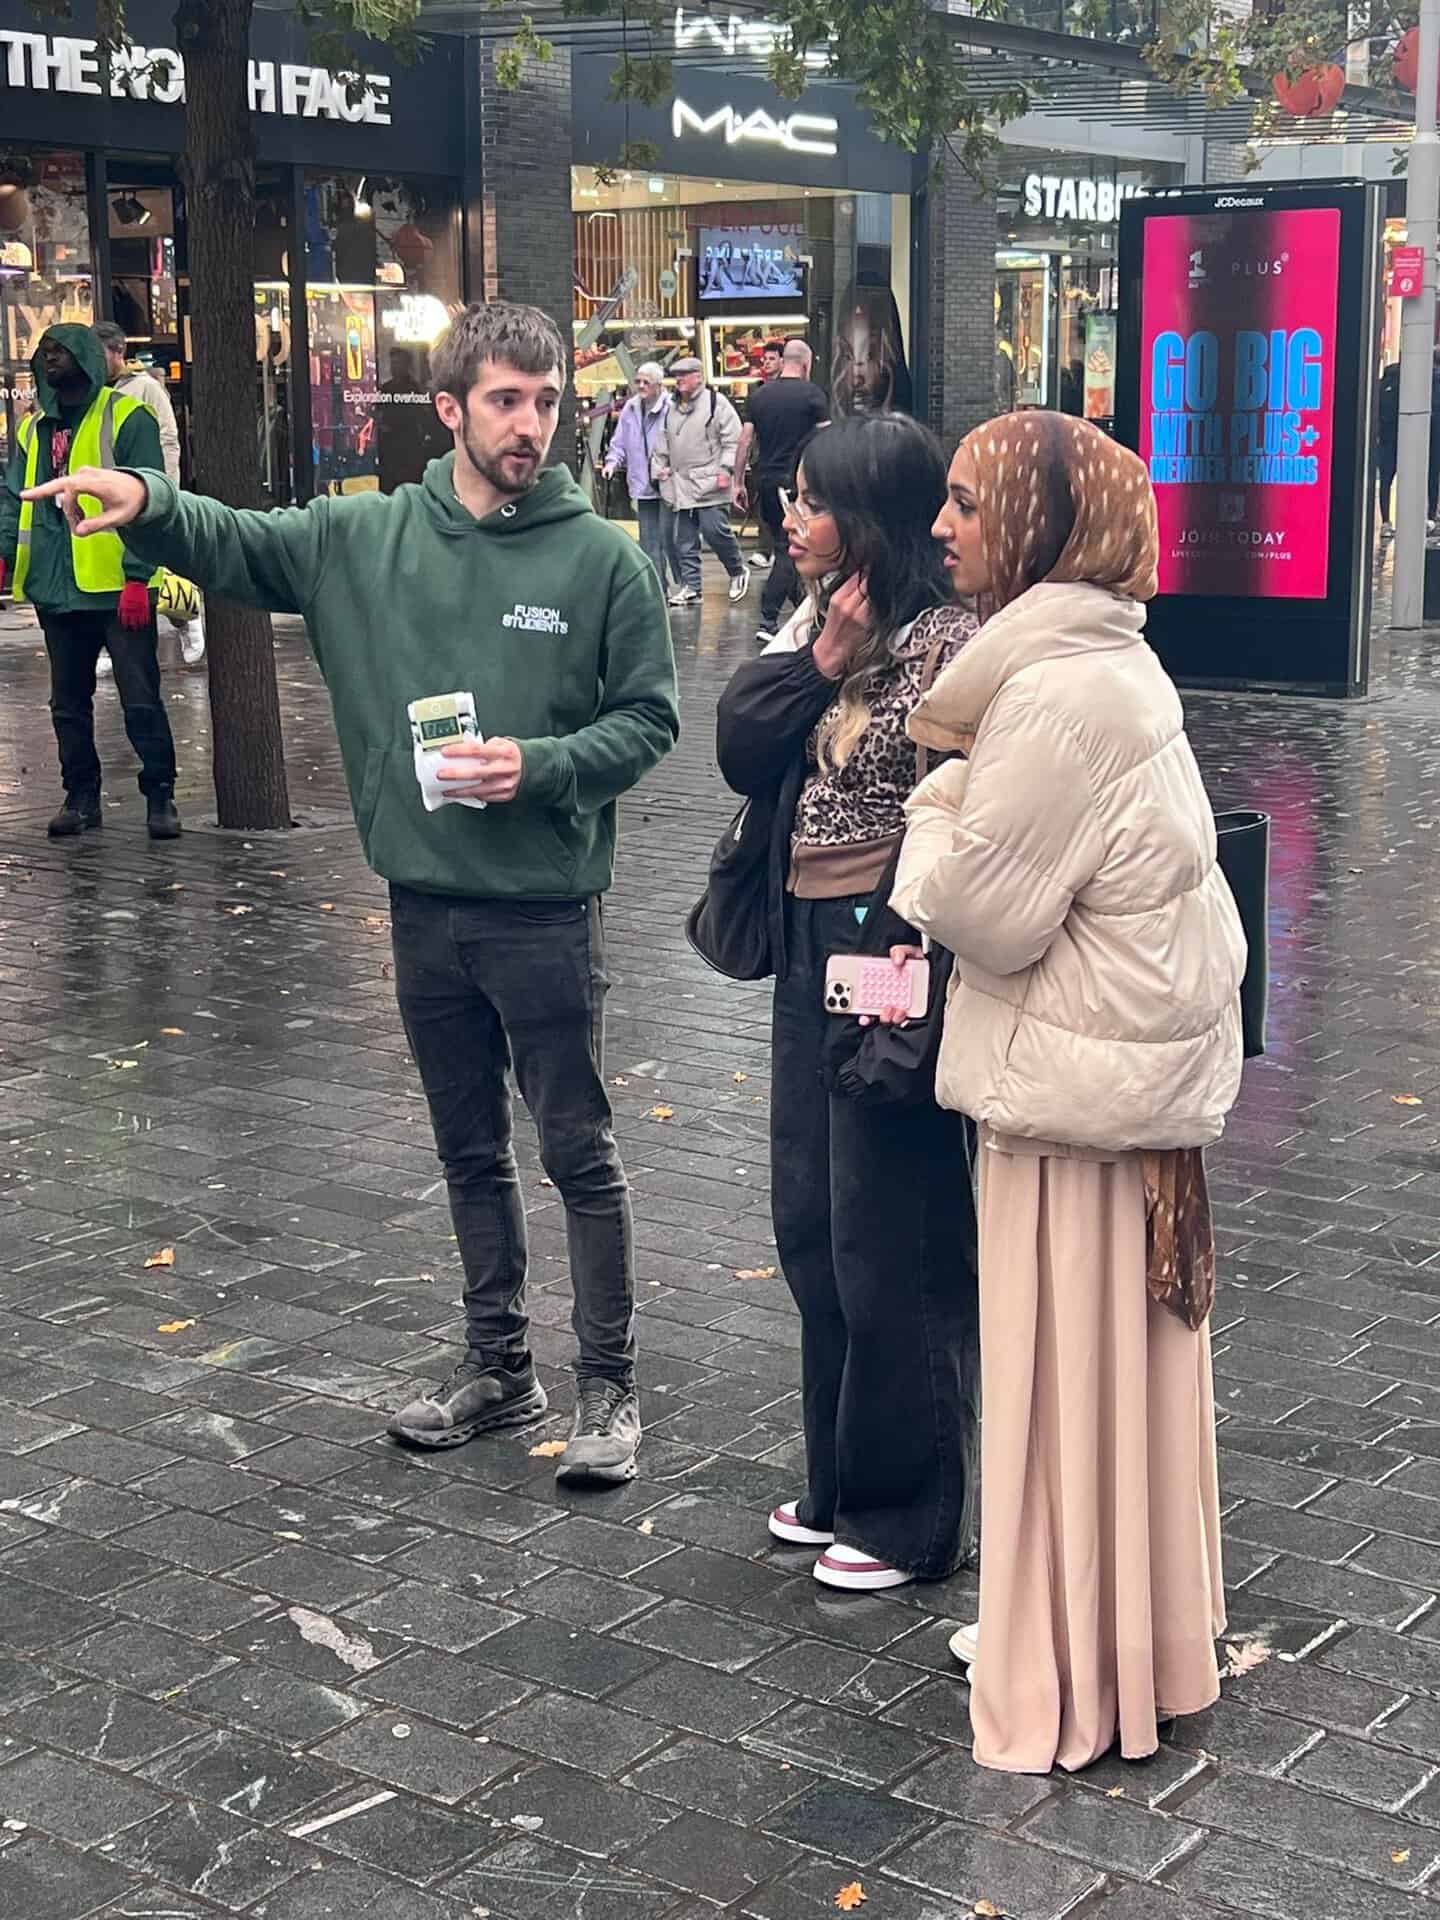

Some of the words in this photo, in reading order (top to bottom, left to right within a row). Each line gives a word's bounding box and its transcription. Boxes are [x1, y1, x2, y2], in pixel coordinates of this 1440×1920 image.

[0, 30, 102, 95] THE
[109, 44, 276, 113] NOH
[280, 64, 392, 125] FACE
[1213, 196, 1265, 208] JCDecaux
[1151, 331, 1219, 412] GO
[1234, 327, 1323, 411] BIG
[343, 390, 392, 405] Exploration
[1151, 412, 1223, 456] WITH
[1230, 411, 1320, 456] PLUS+
[1231, 455, 1318, 485] REWARDS
[1226, 529, 1286, 546] TODAY
[514, 604, 560, 622] FUSION
[502, 614, 569, 634] STUDENTS
